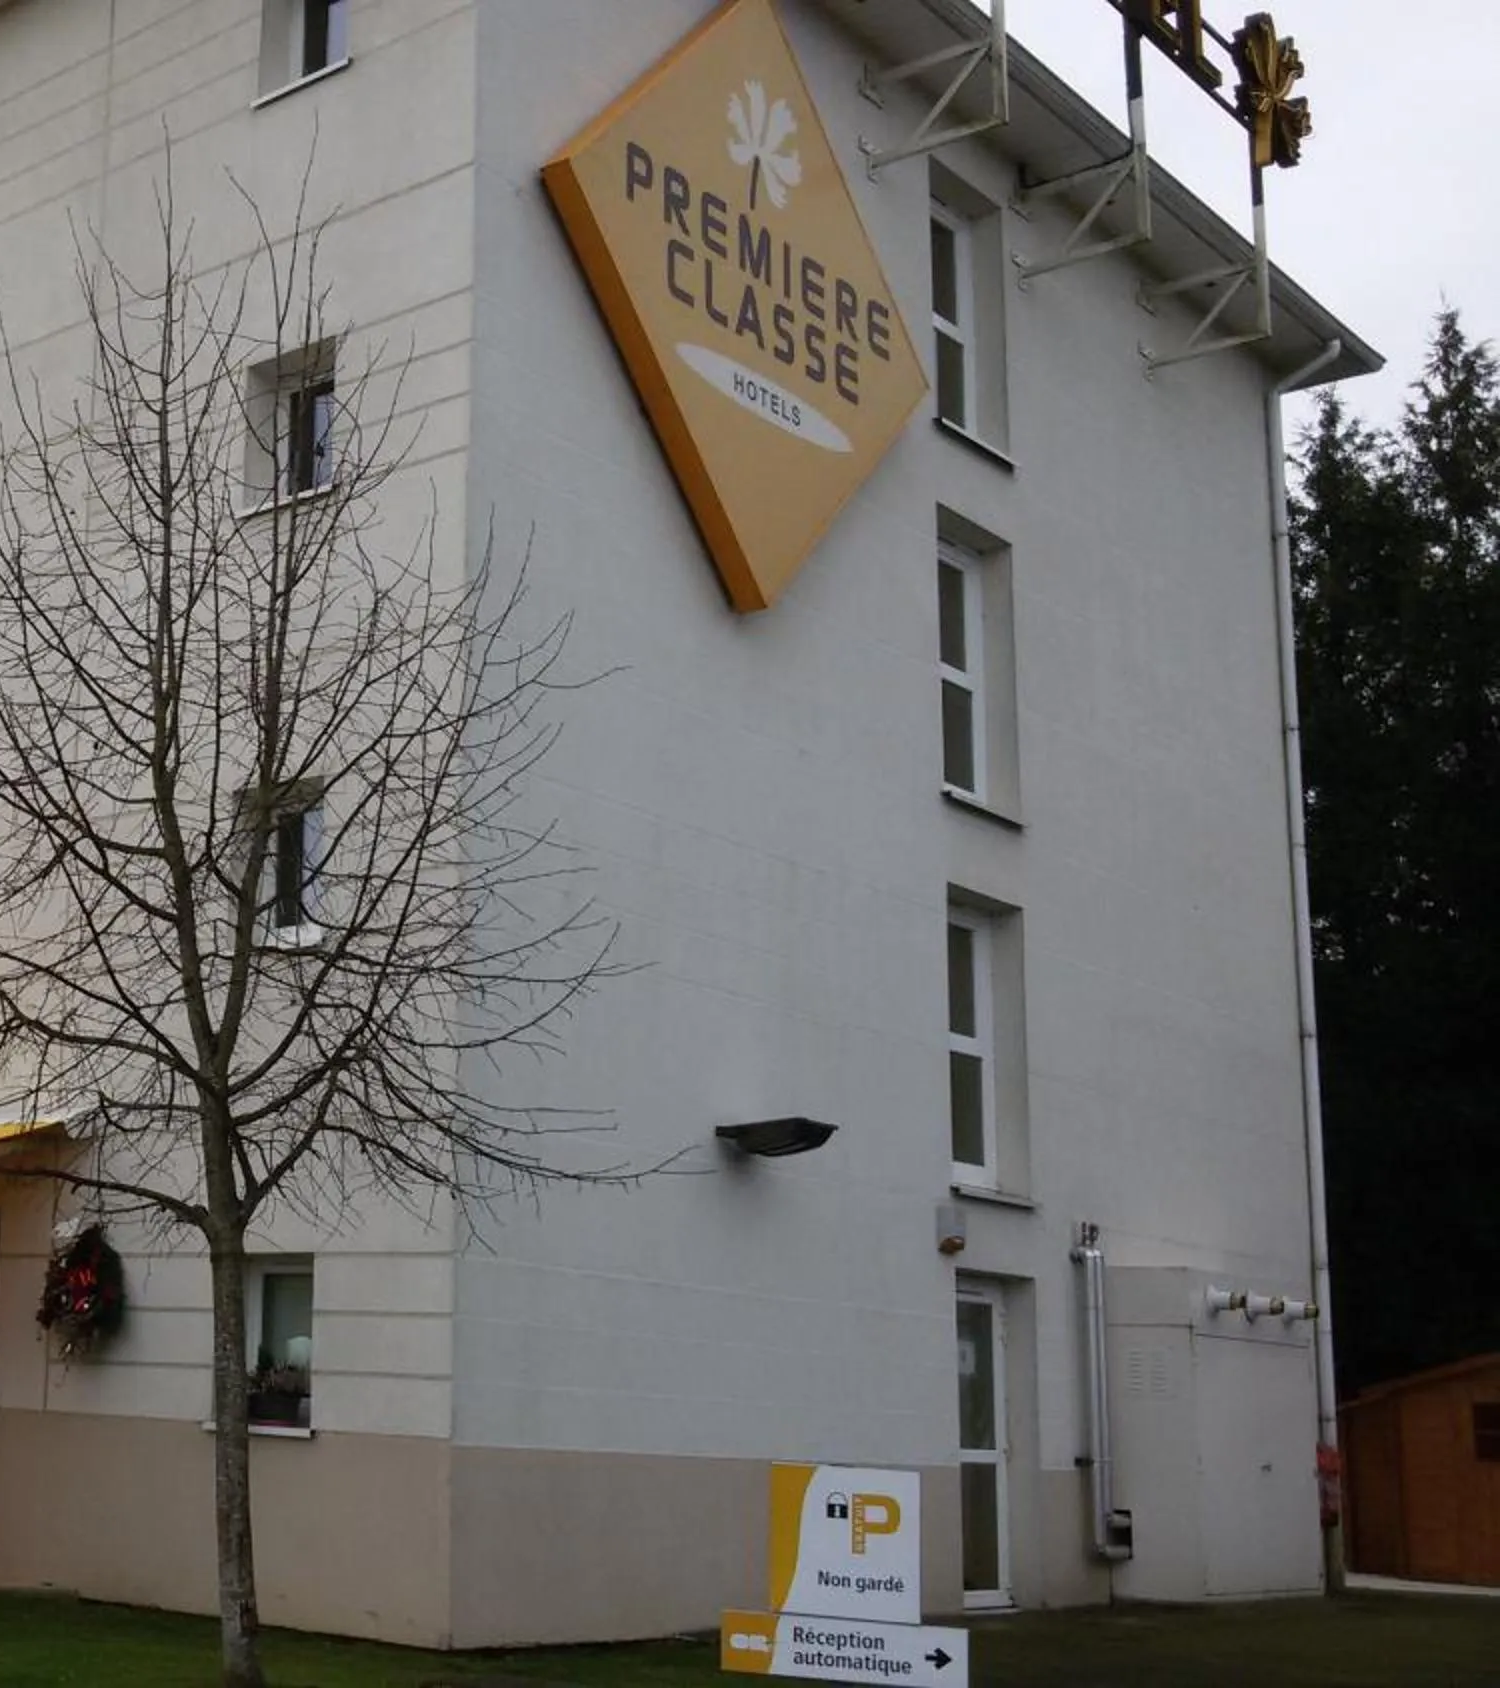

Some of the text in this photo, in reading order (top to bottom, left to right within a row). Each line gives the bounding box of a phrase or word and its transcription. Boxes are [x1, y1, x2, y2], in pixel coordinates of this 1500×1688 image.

[626, 142, 891, 362] PREMIERE
[667, 239, 859, 405] CLASSE
[733, 373, 801, 427] HOTELS
[818, 1570, 904, 1593] Non gardé
[793, 1625, 885, 1650] Réception
[793, 1651, 912, 1676] automatique
